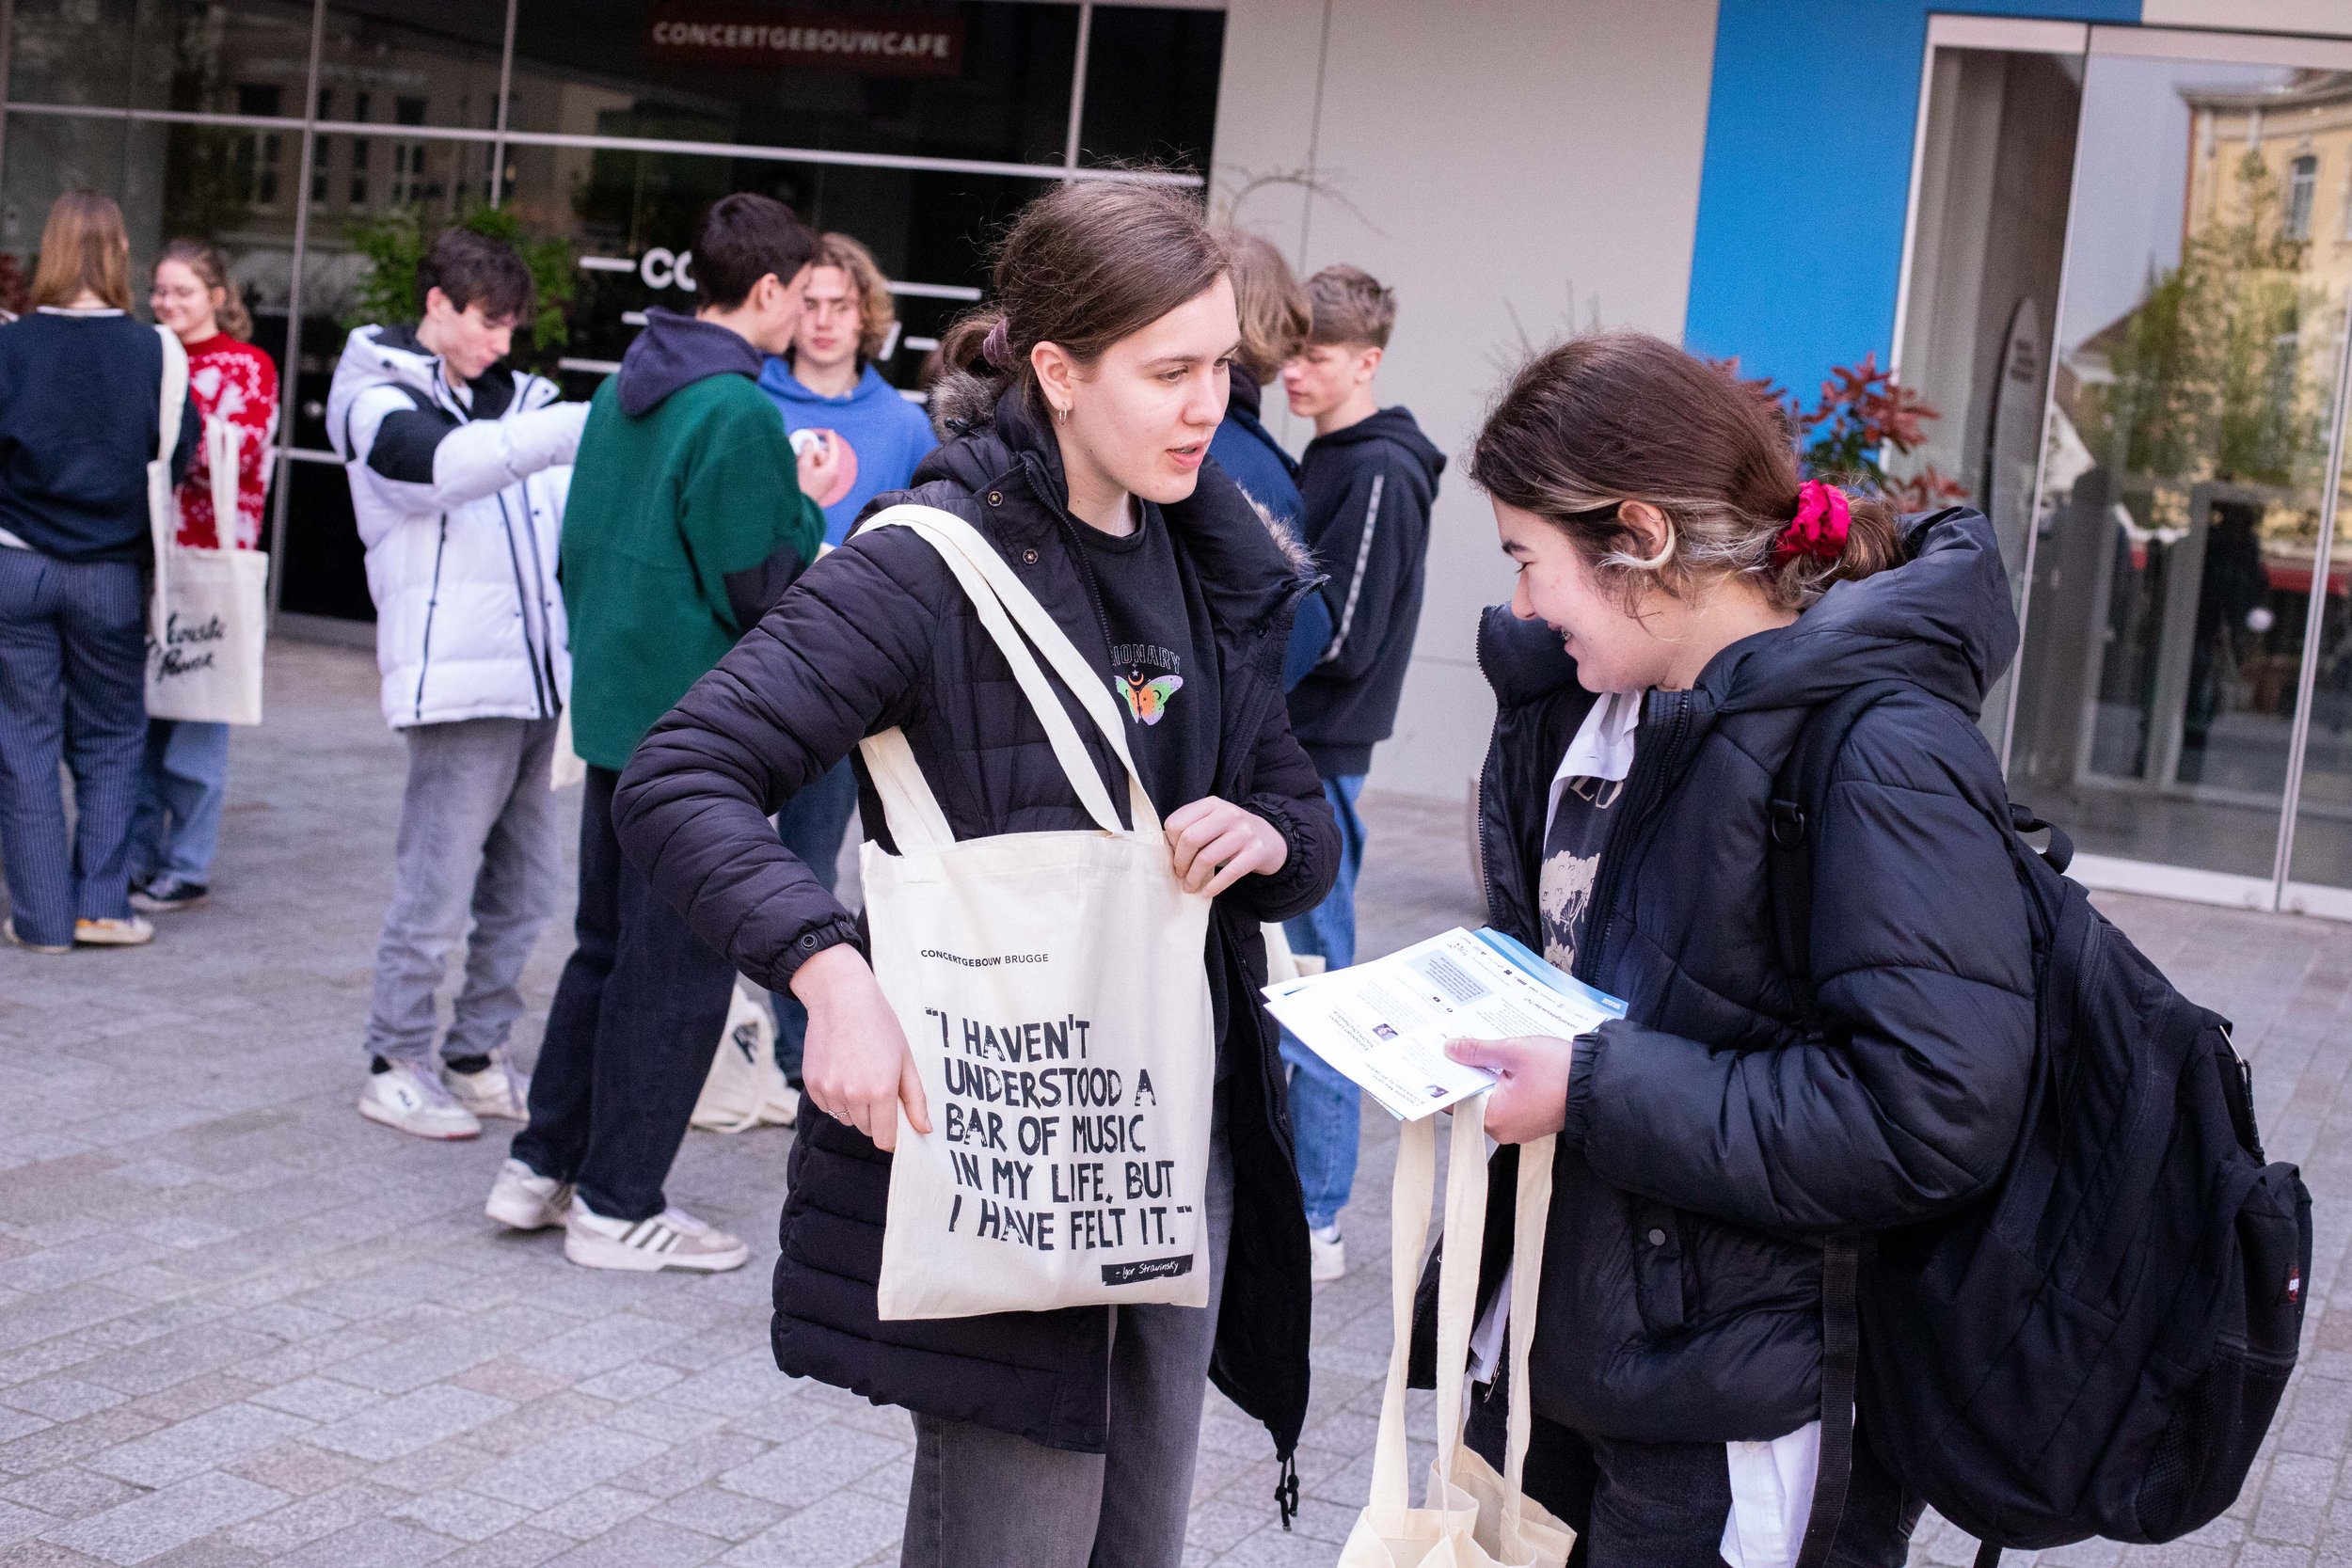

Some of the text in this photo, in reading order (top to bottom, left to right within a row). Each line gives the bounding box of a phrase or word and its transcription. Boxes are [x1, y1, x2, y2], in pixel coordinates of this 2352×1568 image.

[652, 21, 950, 58] CONCERTGEBOUWCAFE
[1112, 643, 1181, 673] IONARY
[921, 949, 1049, 967] CONCERTGEBOUW BRUGGE
[961, 1014, 1090, 1063] HAVEN'T
[944, 1056, 1157, 1110] UNDERSTOOD A
[946, 1103, 1146, 1156] BAR OF MUSIC
[949, 1149, 983, 1191] IN
[993, 1158, 1034, 1201] MY
[1124, 1160, 1175, 1200] BUT
[948, 1194, 962, 1233] I
[977, 1198, 1055, 1251] HAVE
[1070, 1208, 1126, 1251] FELT
[1122, 1266, 1136, 1280] Igor
